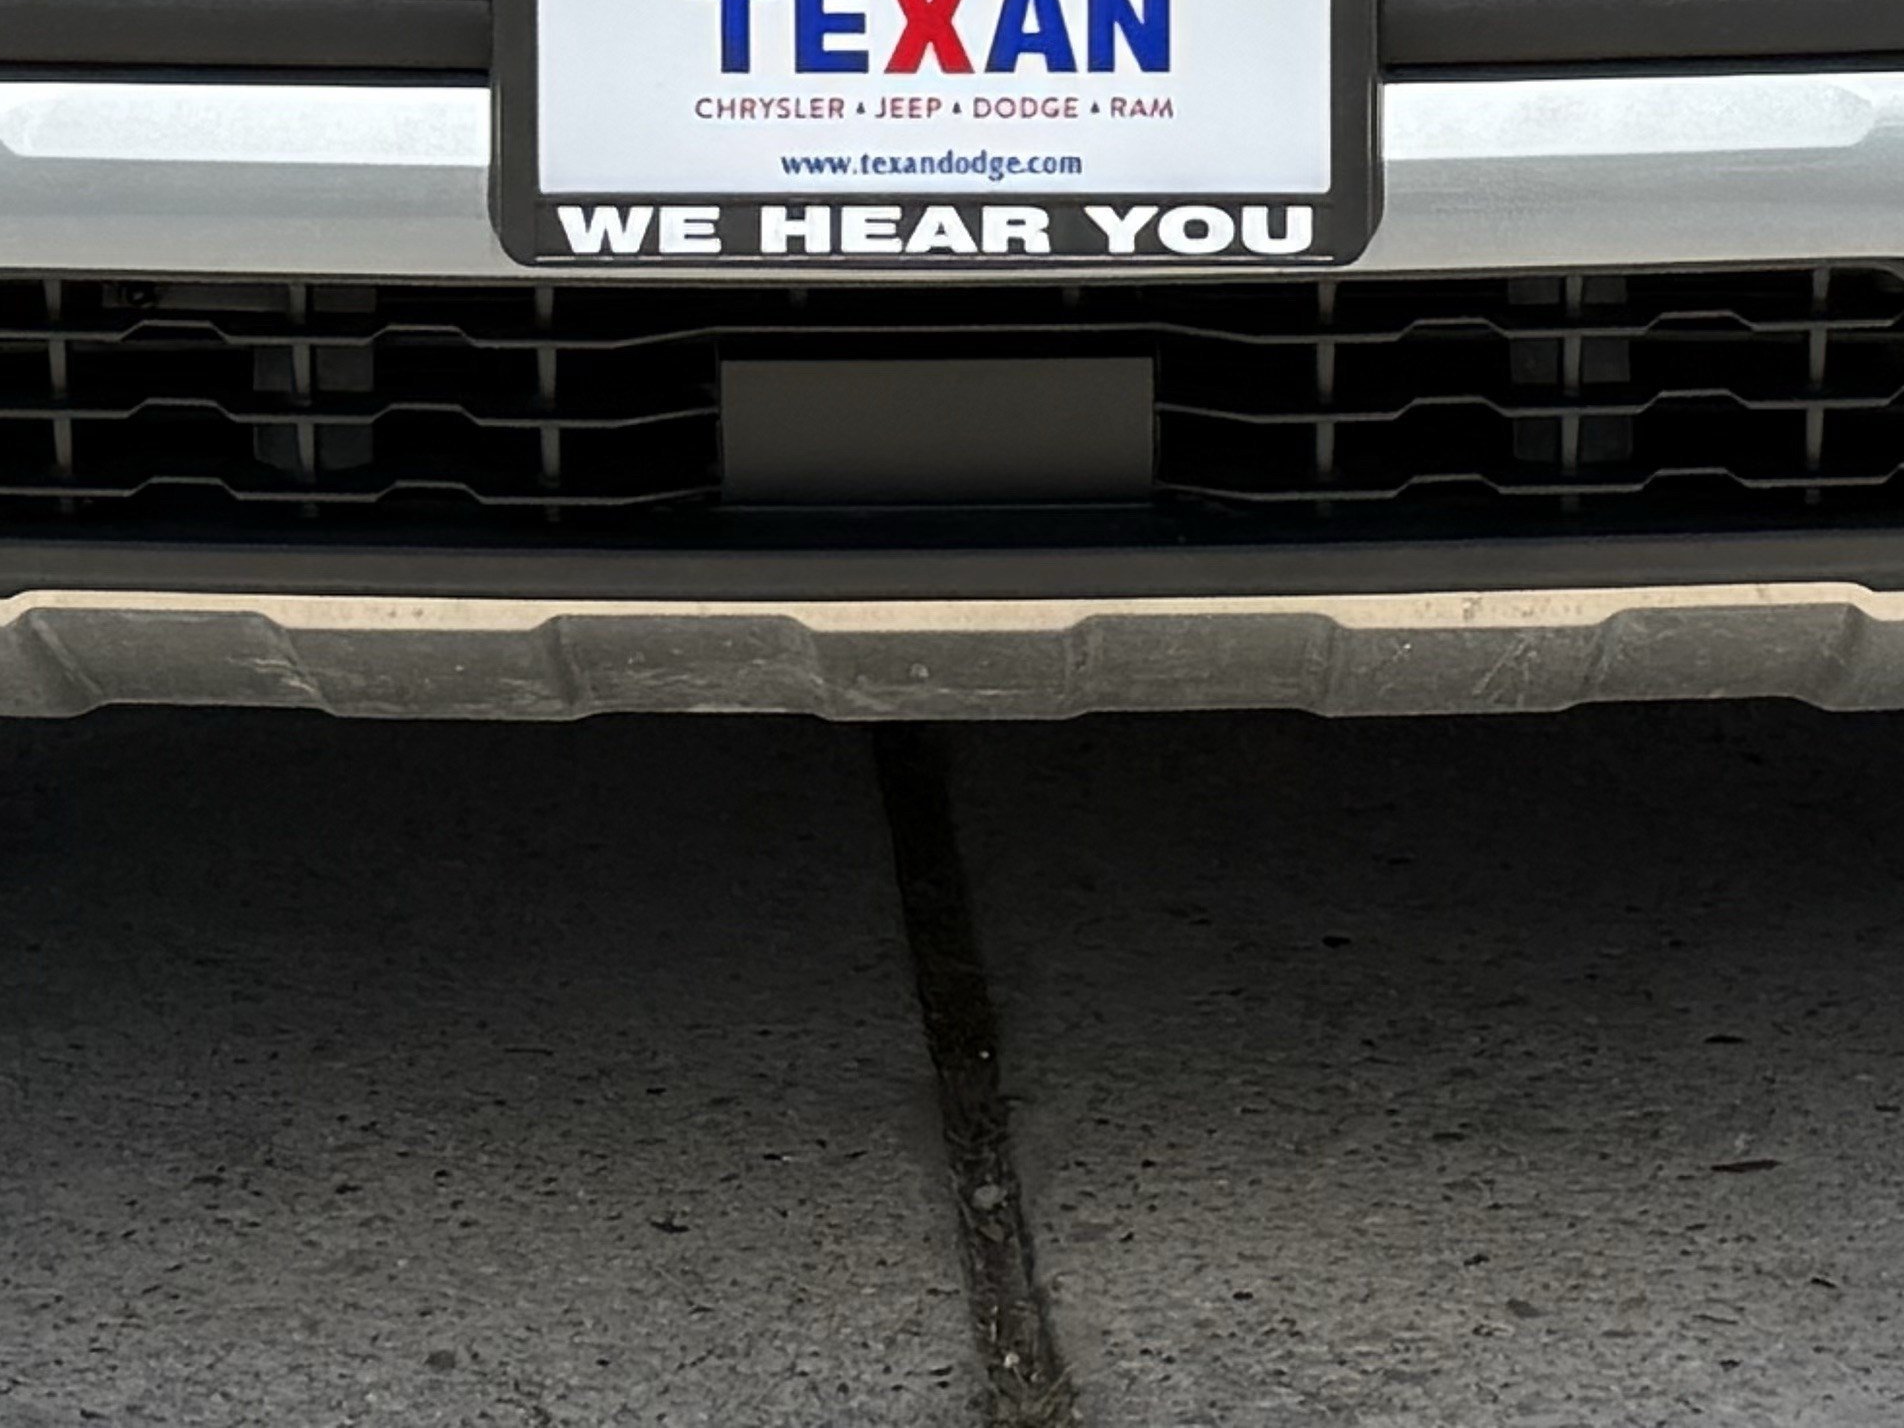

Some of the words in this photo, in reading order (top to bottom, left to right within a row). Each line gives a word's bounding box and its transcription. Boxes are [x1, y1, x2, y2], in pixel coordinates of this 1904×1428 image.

[694, 96, 846, 121] CHRYSLER
[873, 96, 943, 120] JEEP
[972, 96, 1080, 120] DODGE
[1109, 96, 1175, 120] RAM
[780, 148, 1084, 183] www.texandodge.com
[556, 205, 723, 254] WE
[759, 205, 1052, 254] HEAR
[1083, 205, 1314, 255] YOU
